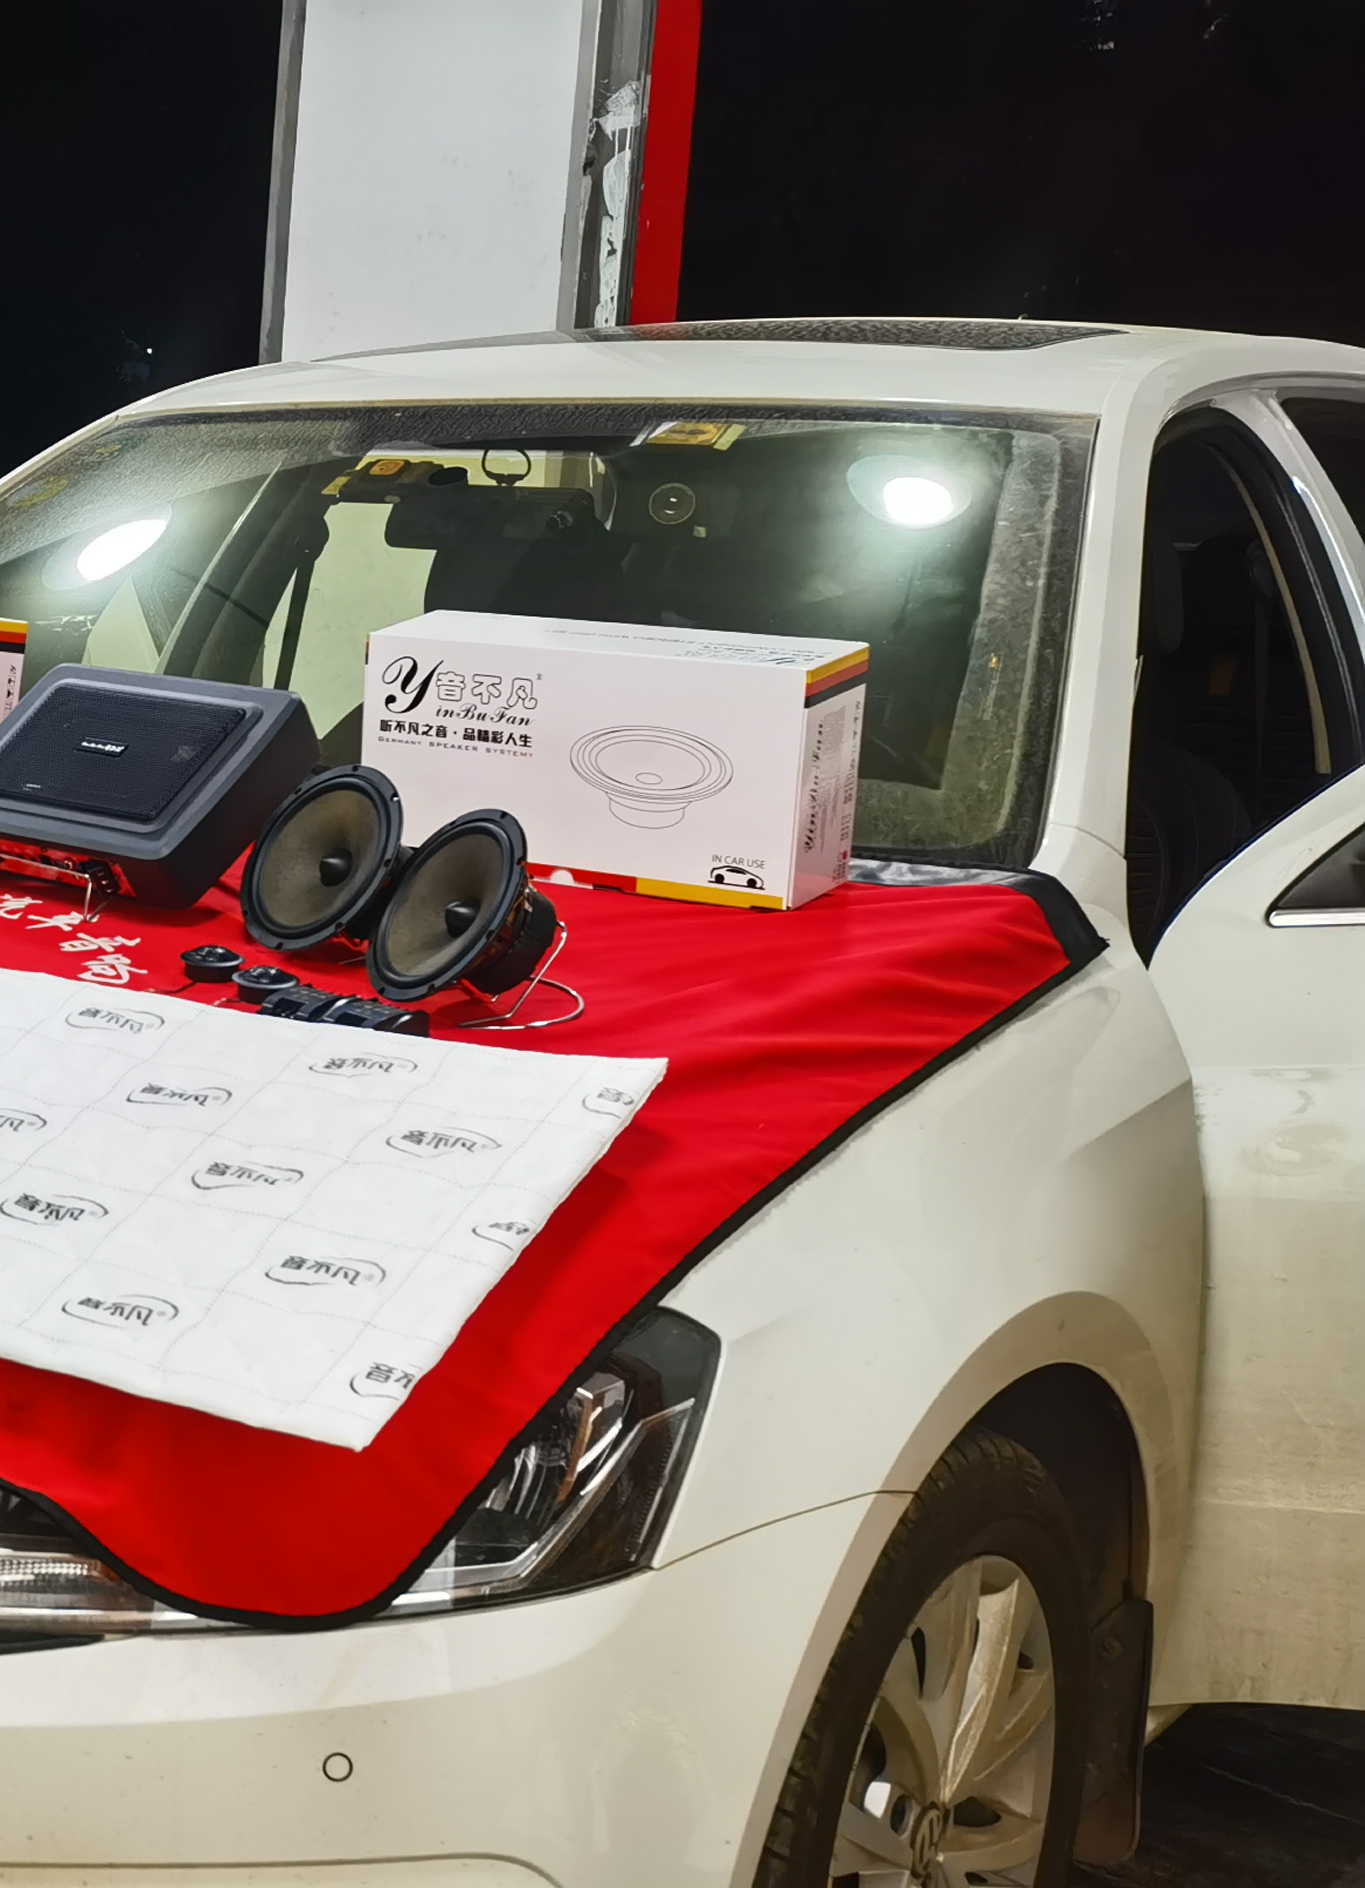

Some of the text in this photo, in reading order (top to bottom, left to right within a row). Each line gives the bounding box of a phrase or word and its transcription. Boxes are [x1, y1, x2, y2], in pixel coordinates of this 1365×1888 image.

[435, 670, 539, 711] 音不凡
[377, 735, 422, 746] GERMANY
[429, 740, 479, 752] SPEAKER
[711, 854, 767, 870] IN CAR USE
